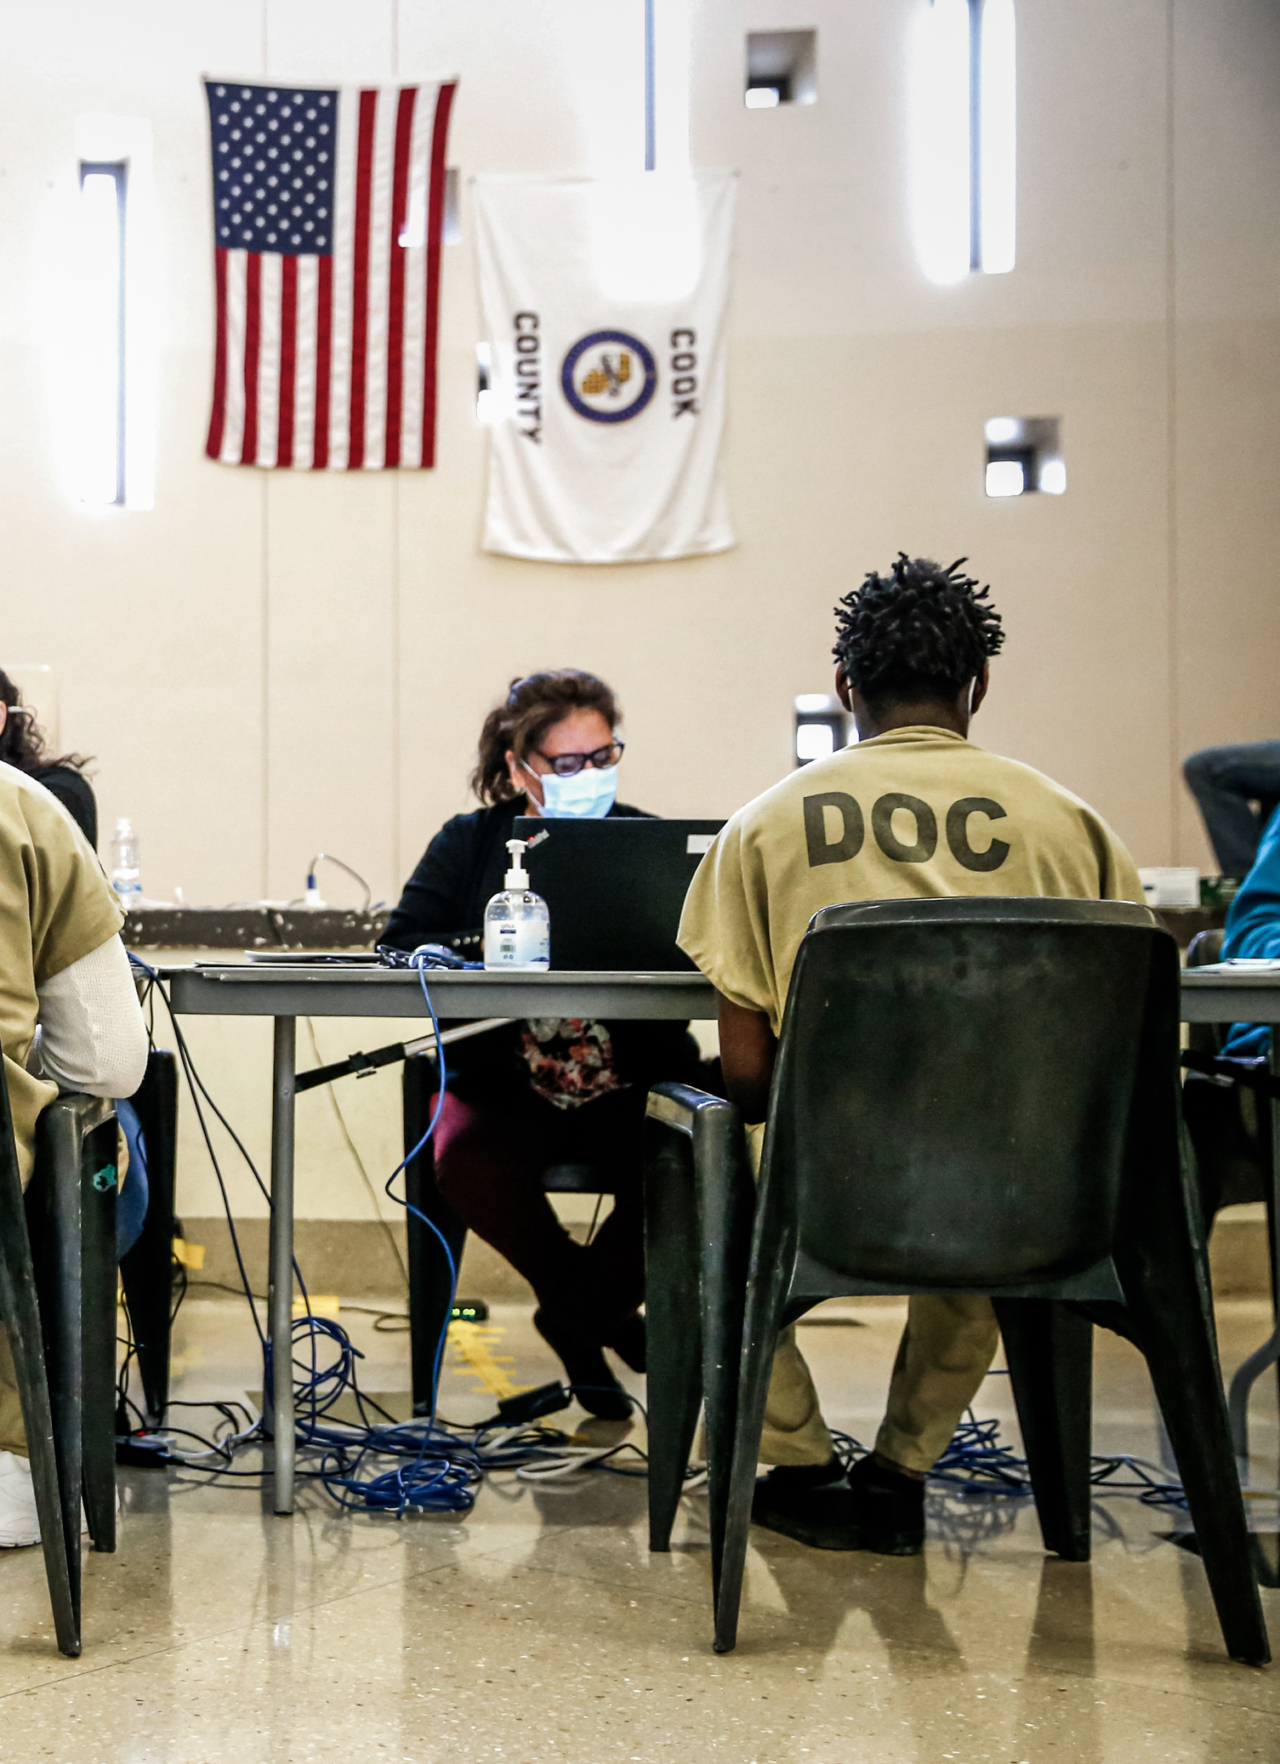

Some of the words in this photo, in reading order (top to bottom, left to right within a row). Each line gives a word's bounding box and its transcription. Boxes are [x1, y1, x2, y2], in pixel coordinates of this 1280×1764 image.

[514, 311, 542, 444] COUNTY
[671, 328, 700, 420] COOK
[803, 791, 1011, 872] DOC
